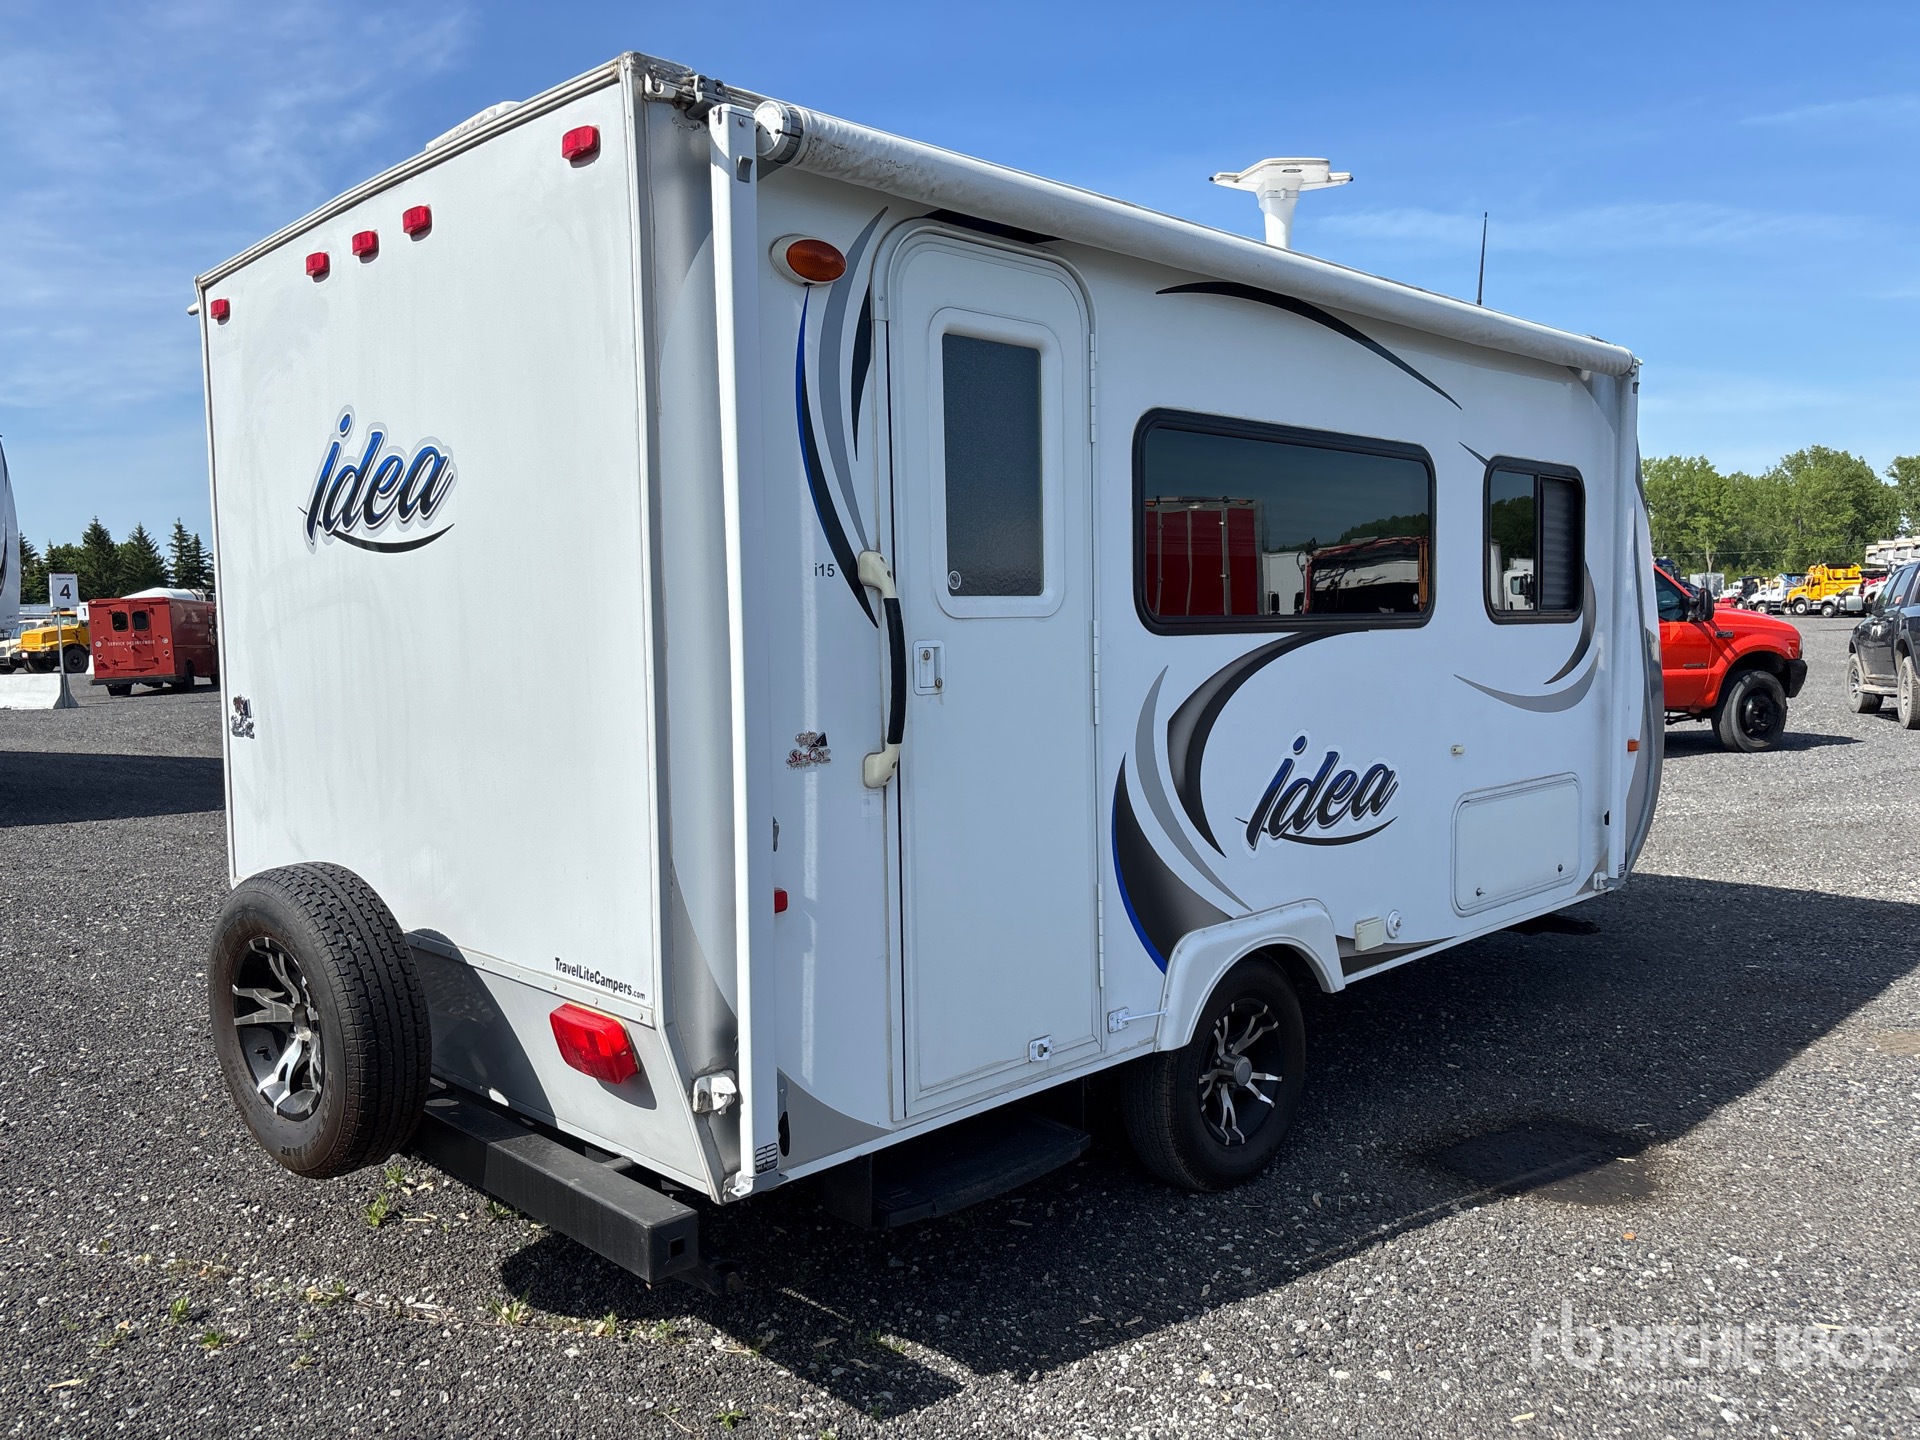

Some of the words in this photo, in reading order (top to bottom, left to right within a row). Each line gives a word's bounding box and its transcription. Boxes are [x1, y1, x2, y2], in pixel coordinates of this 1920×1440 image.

[306, 413, 454, 545] idea
[60, 584, 71, 599] 4
[814, 562, 835, 578] i15
[1246, 735, 1399, 851] idea
[555, 957, 645, 1000] TravelLiteCampers.com
